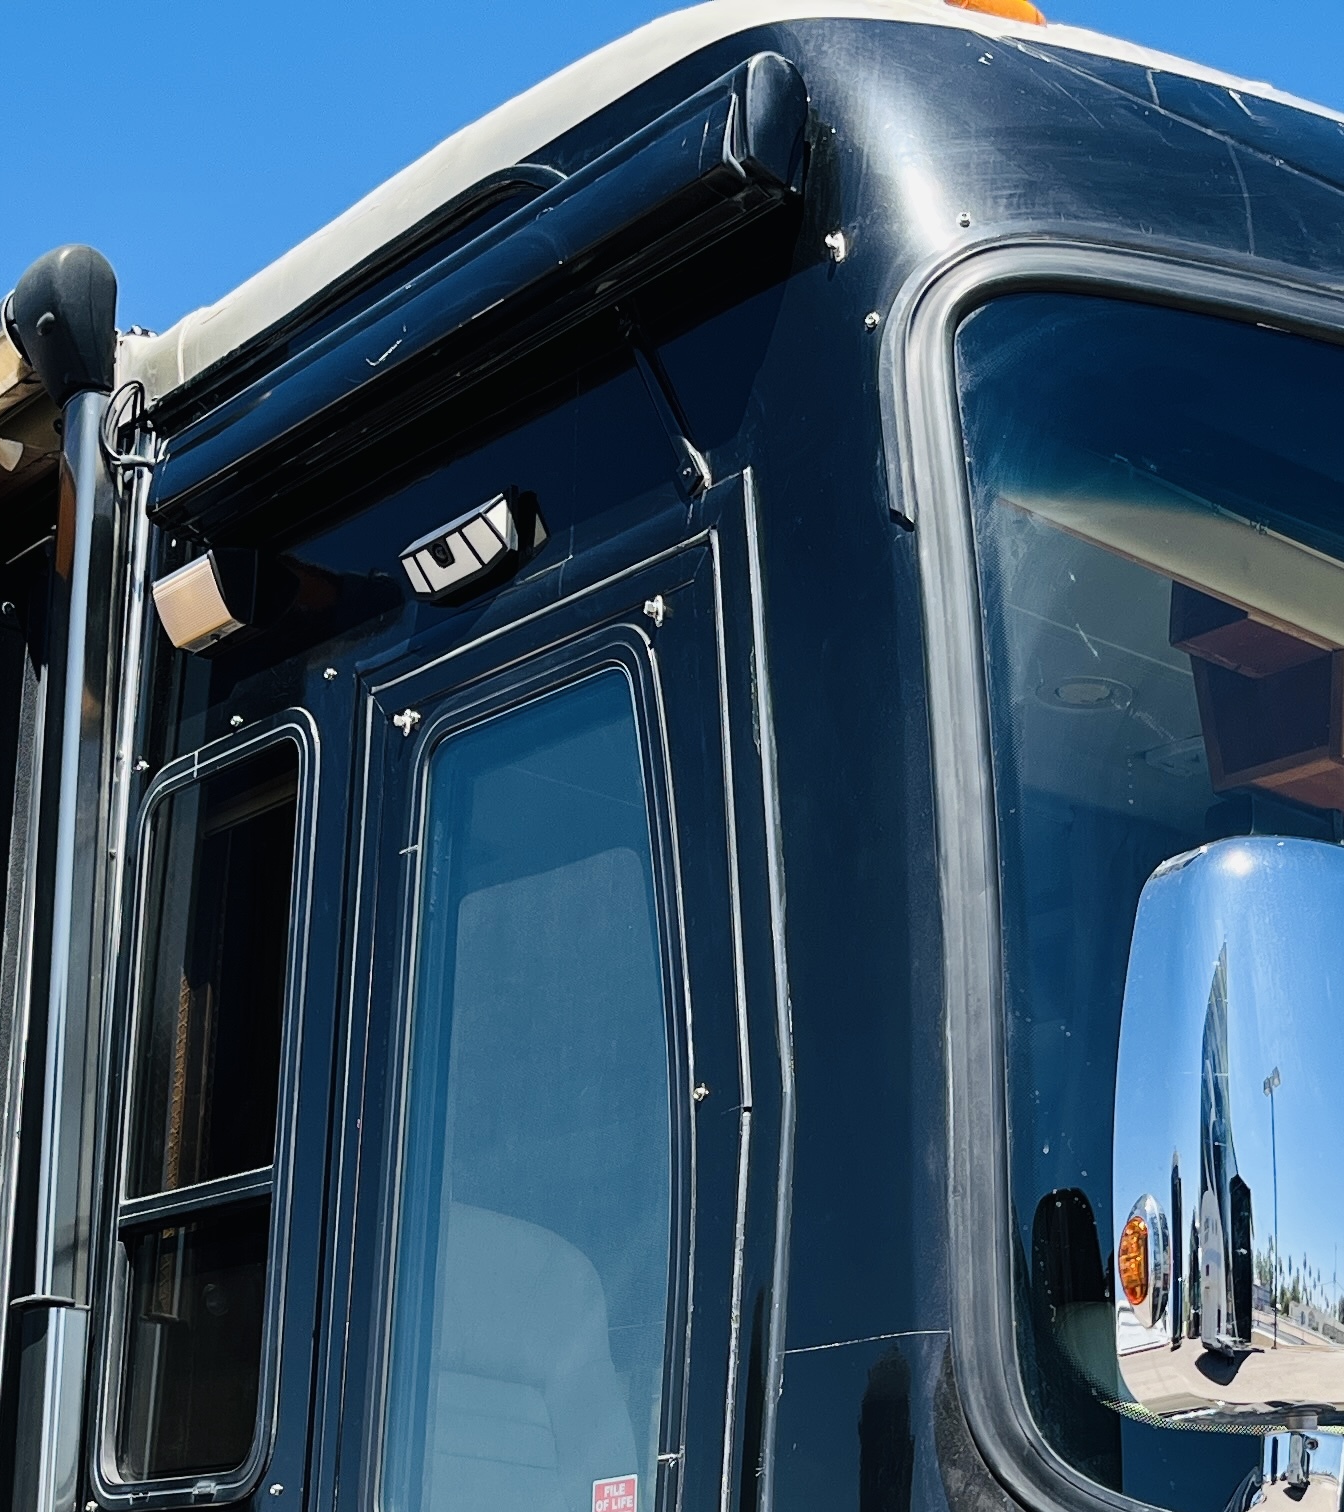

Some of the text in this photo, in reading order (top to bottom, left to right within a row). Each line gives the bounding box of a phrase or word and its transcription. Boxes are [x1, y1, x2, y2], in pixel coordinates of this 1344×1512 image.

[603, 1483, 626, 1499] FILE
[595, 1495, 633, 1512] OF LIFE
